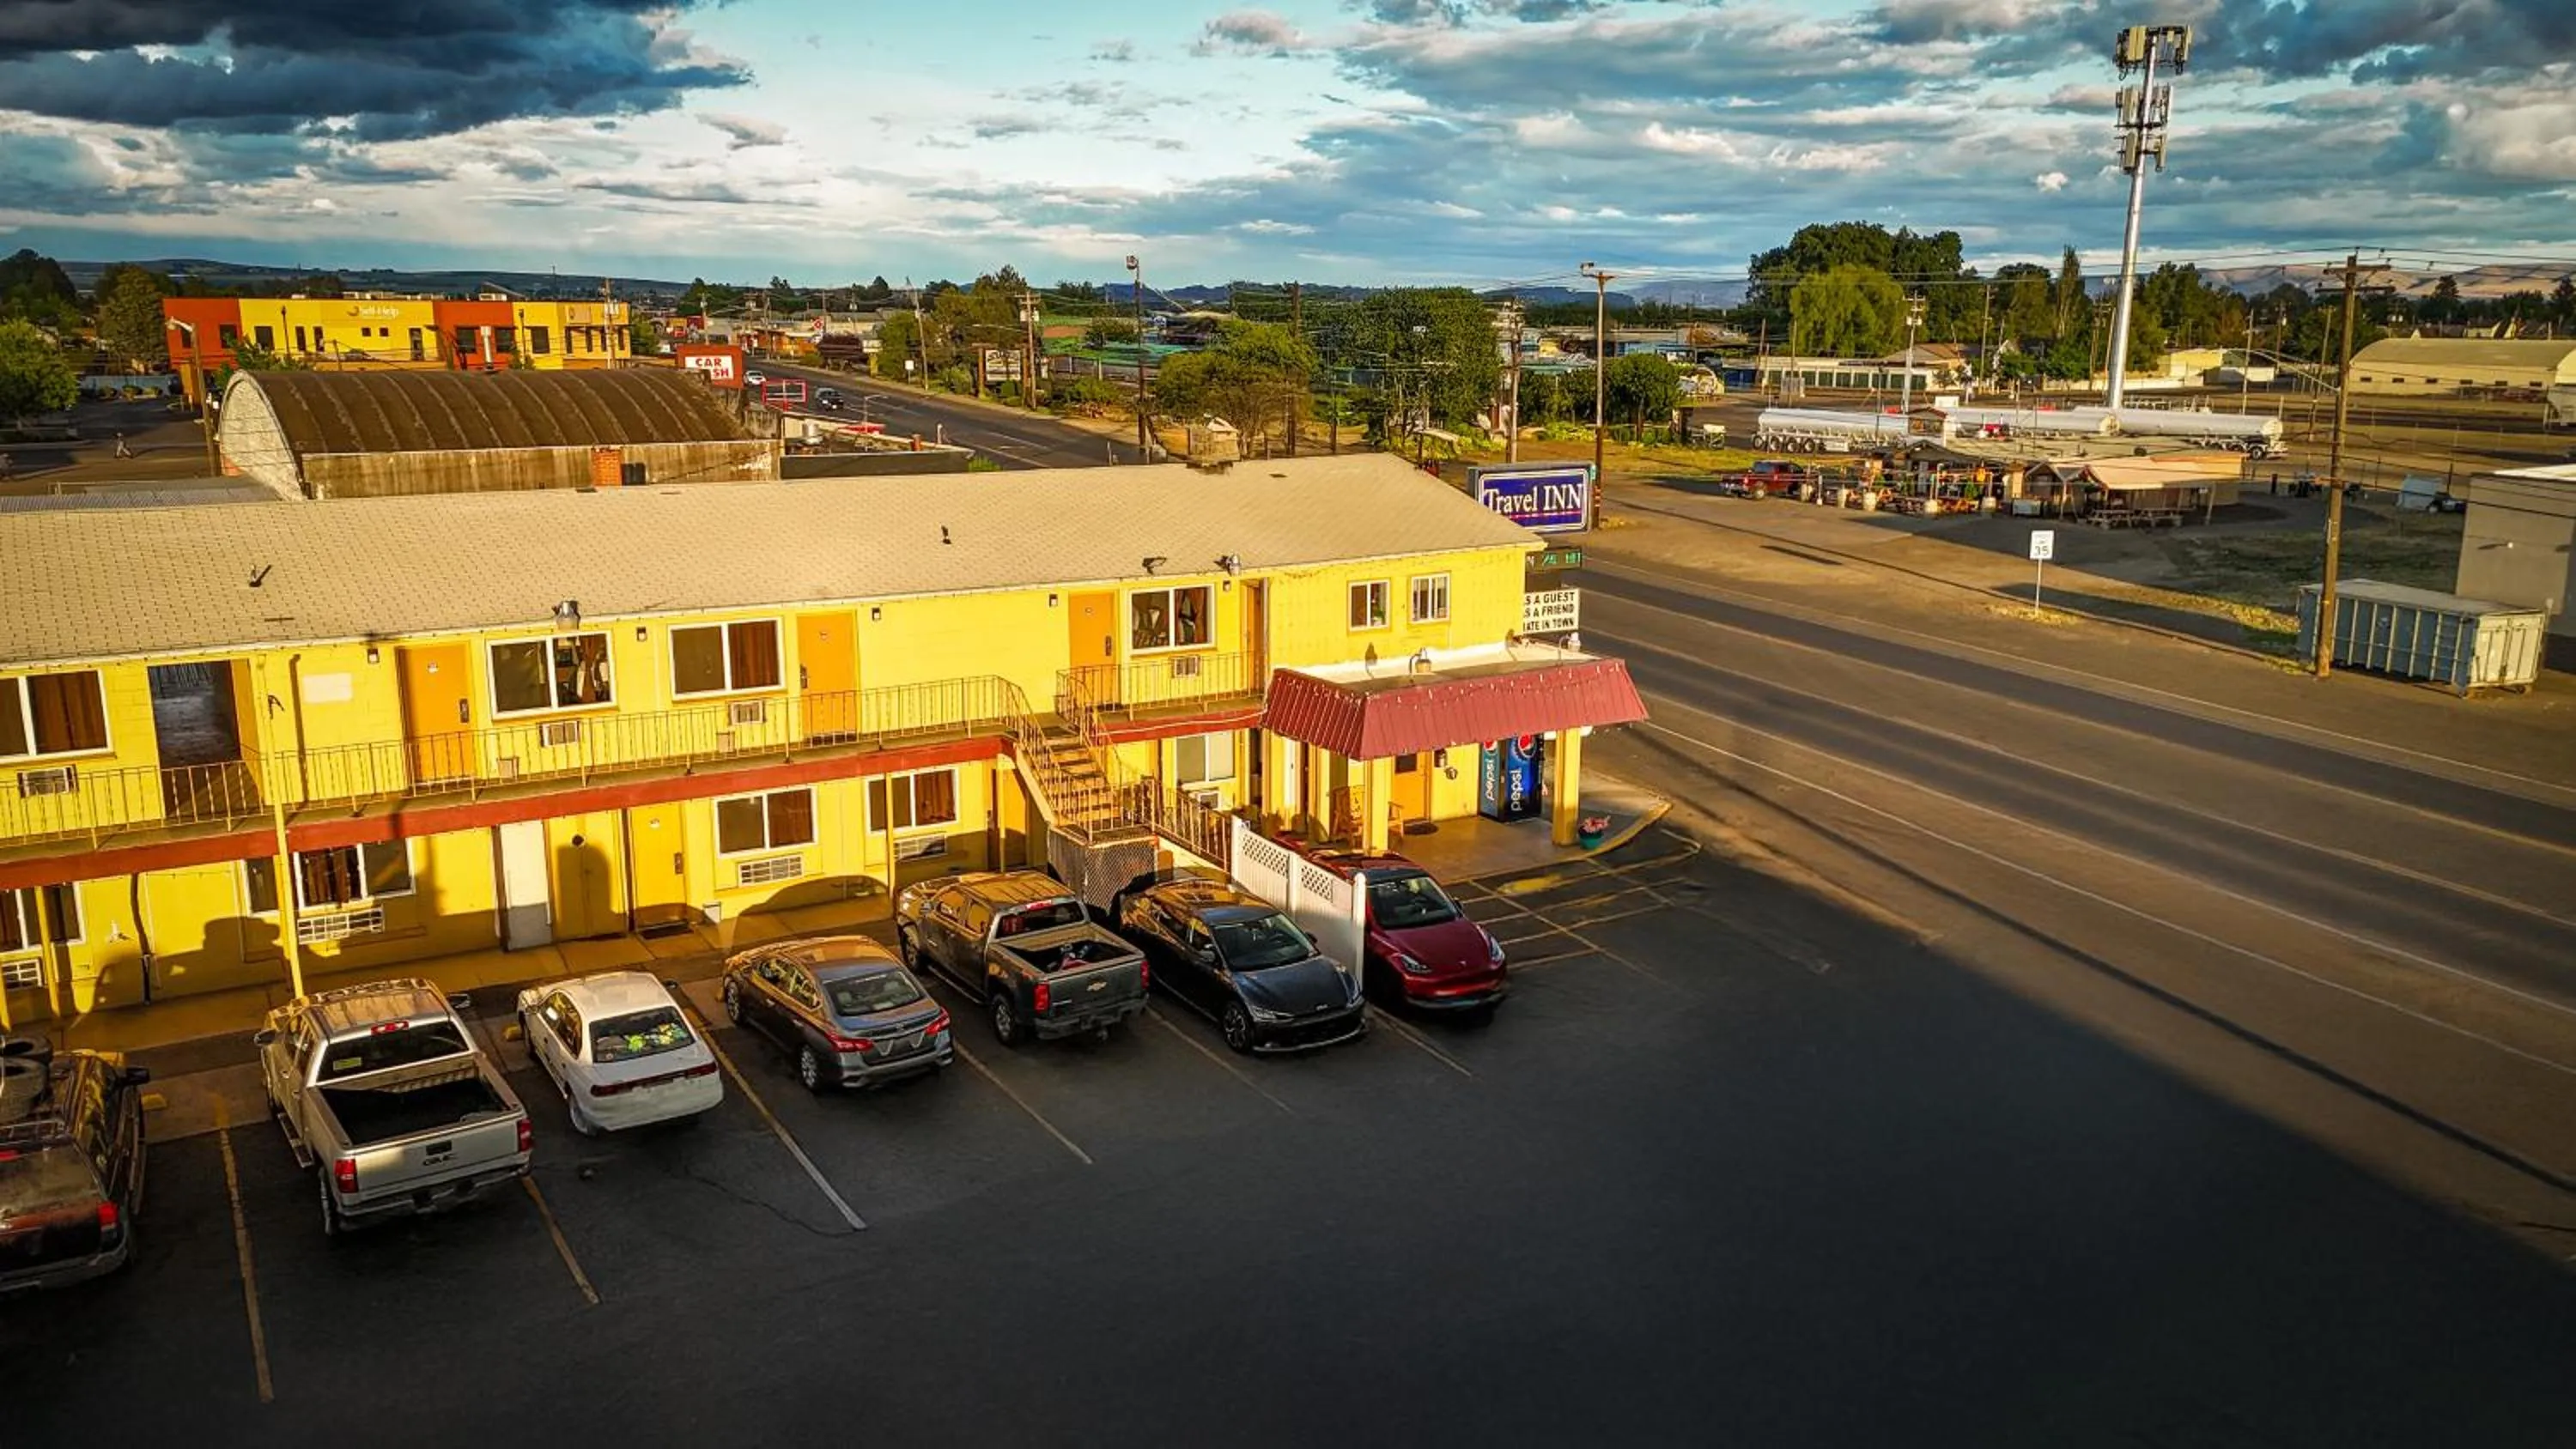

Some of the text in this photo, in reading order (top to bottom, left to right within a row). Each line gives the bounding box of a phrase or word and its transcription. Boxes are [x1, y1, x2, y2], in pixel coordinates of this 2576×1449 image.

[696, 358, 721, 367] CAR
[713, 368, 729, 378] SH
[1484, 483, 1584, 512] Travel INN
[2034, 545, 2049, 557] 35
[1534, 595, 1540, 604] A
[1543, 591, 1575, 603] GUEST
[1533, 607, 1540, 617] A
[1541, 603, 1574, 616] FRIEND
[1542, 619, 1550, 629] IN
[1552, 617, 1574, 628] TOWN
[1485, 759, 1495, 800] pepsi
[1510, 767, 1523, 811] pepsi
